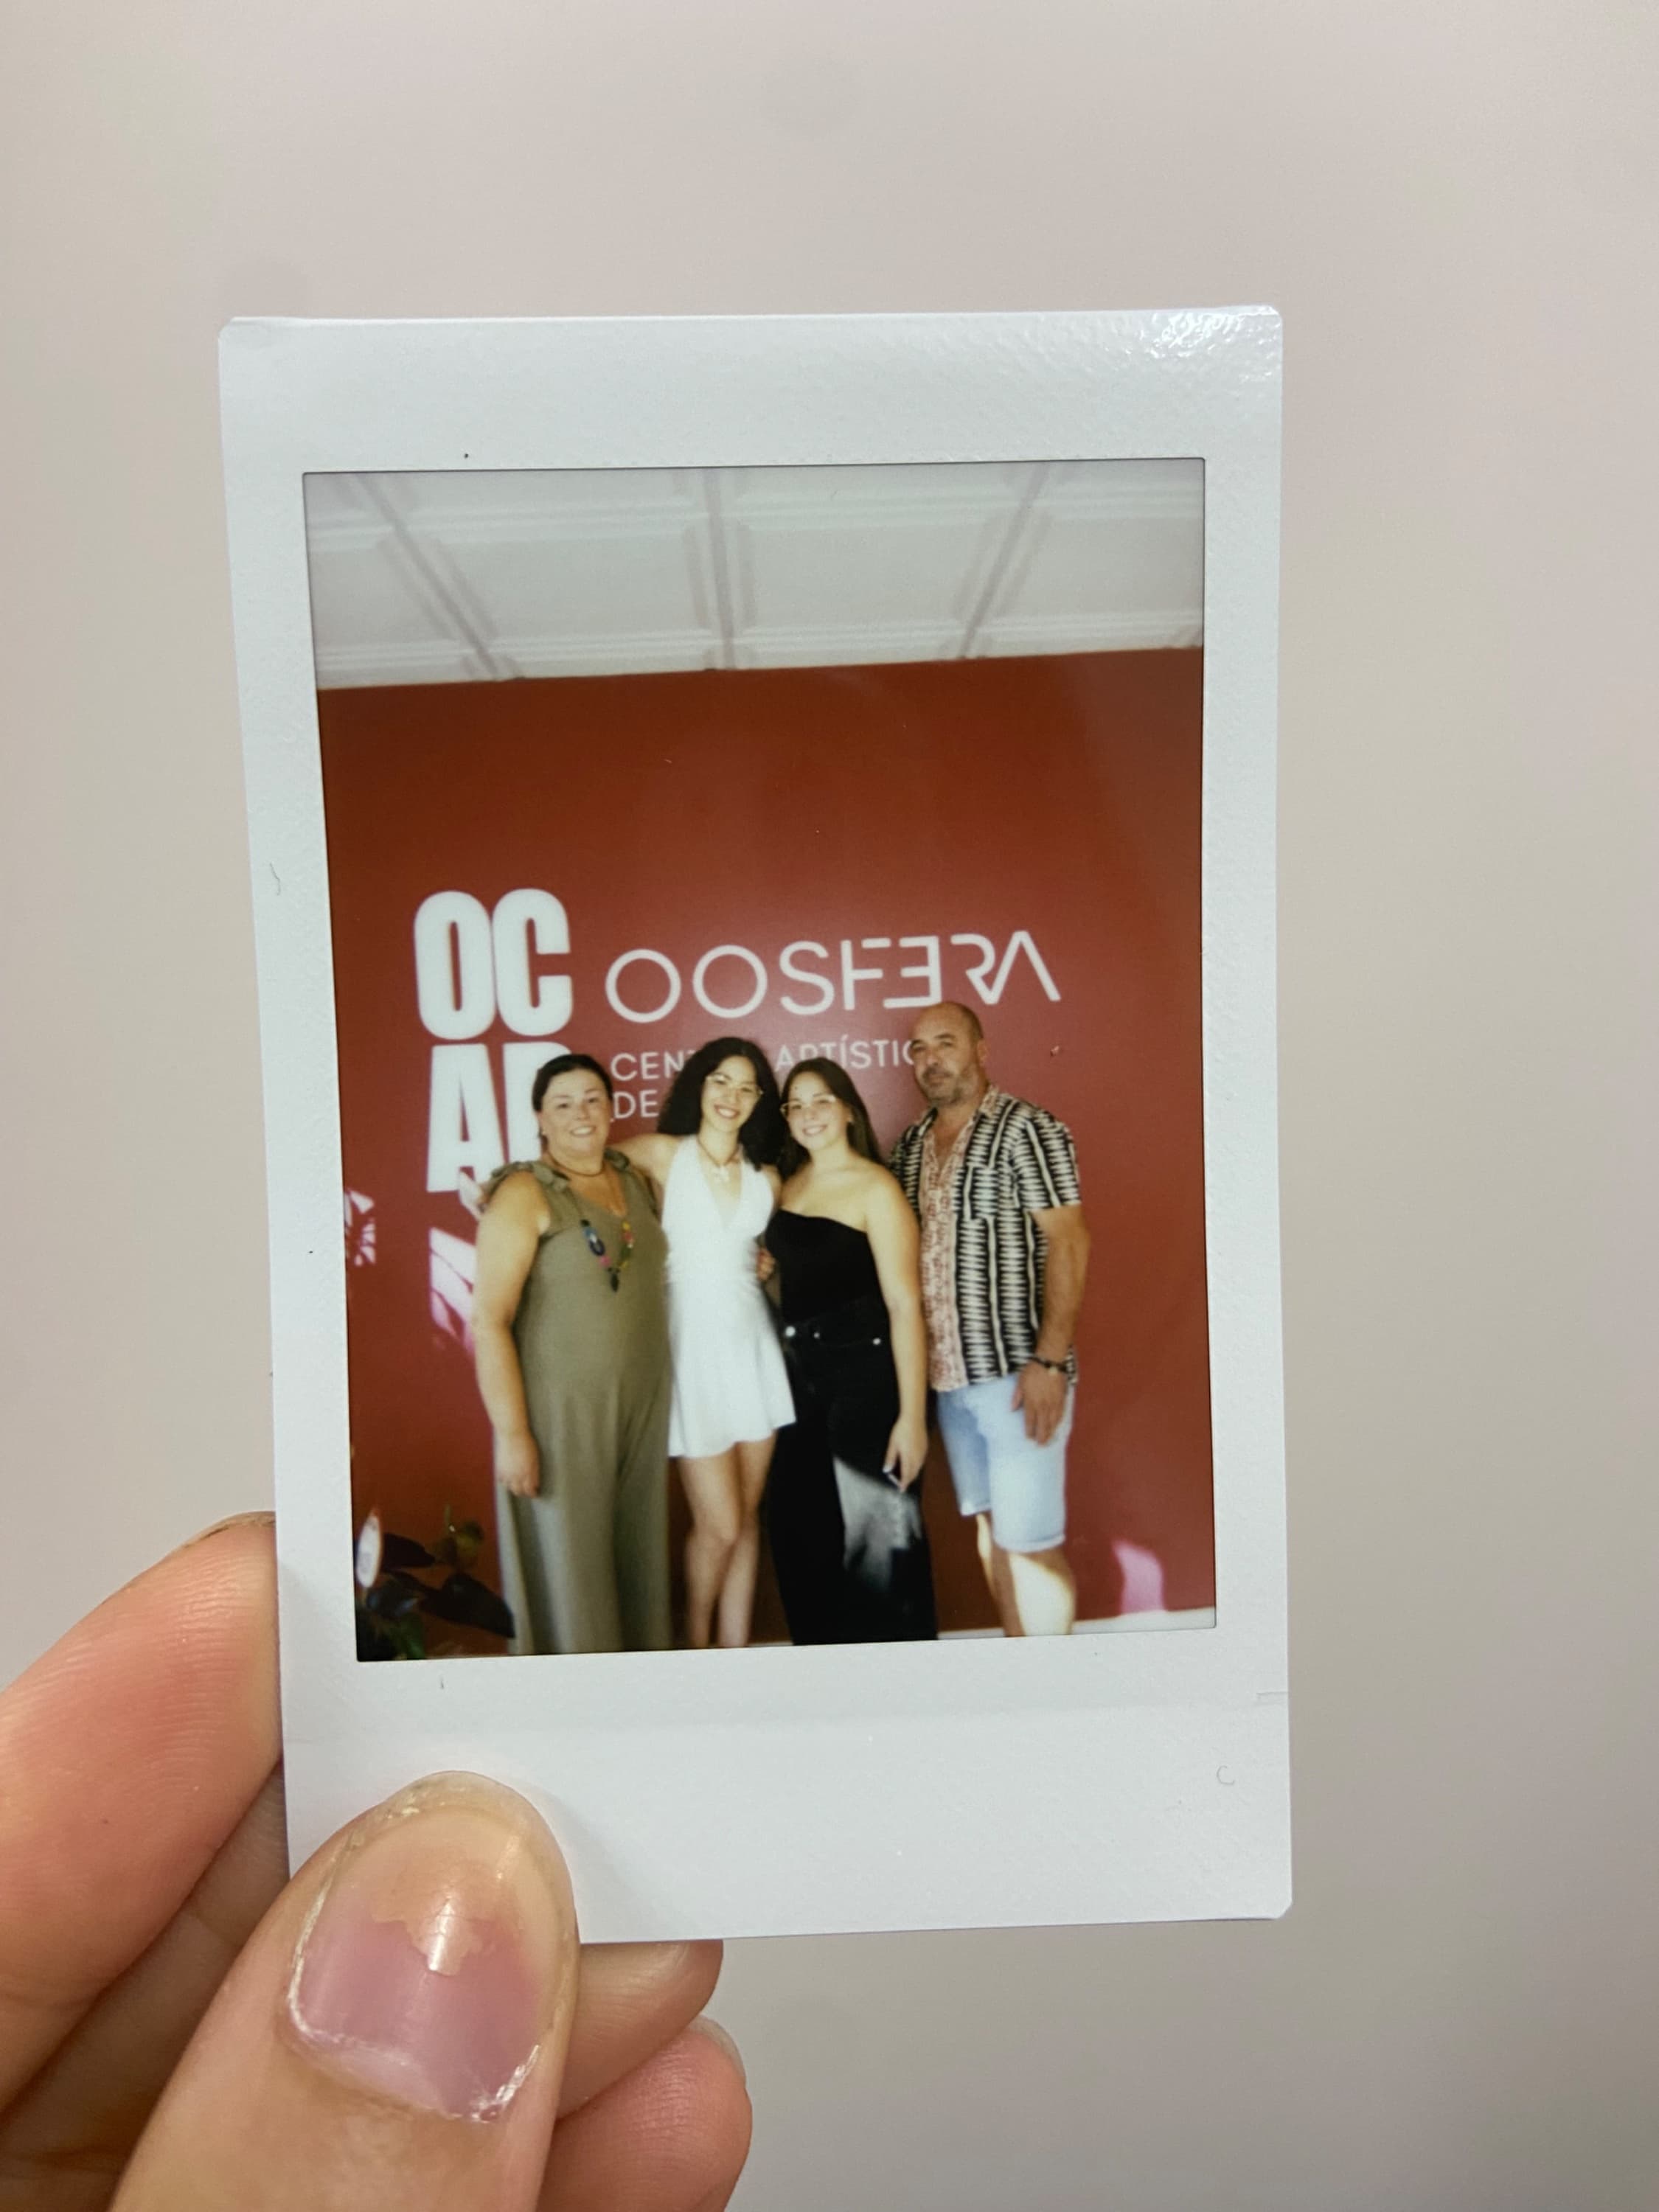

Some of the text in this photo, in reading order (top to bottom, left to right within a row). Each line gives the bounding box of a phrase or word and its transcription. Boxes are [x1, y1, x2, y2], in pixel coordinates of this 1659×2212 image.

[414, 888, 573, 1040] OC
[611, 1049, 696, 1081] CEN
[613, 1090, 659, 1119] DE
